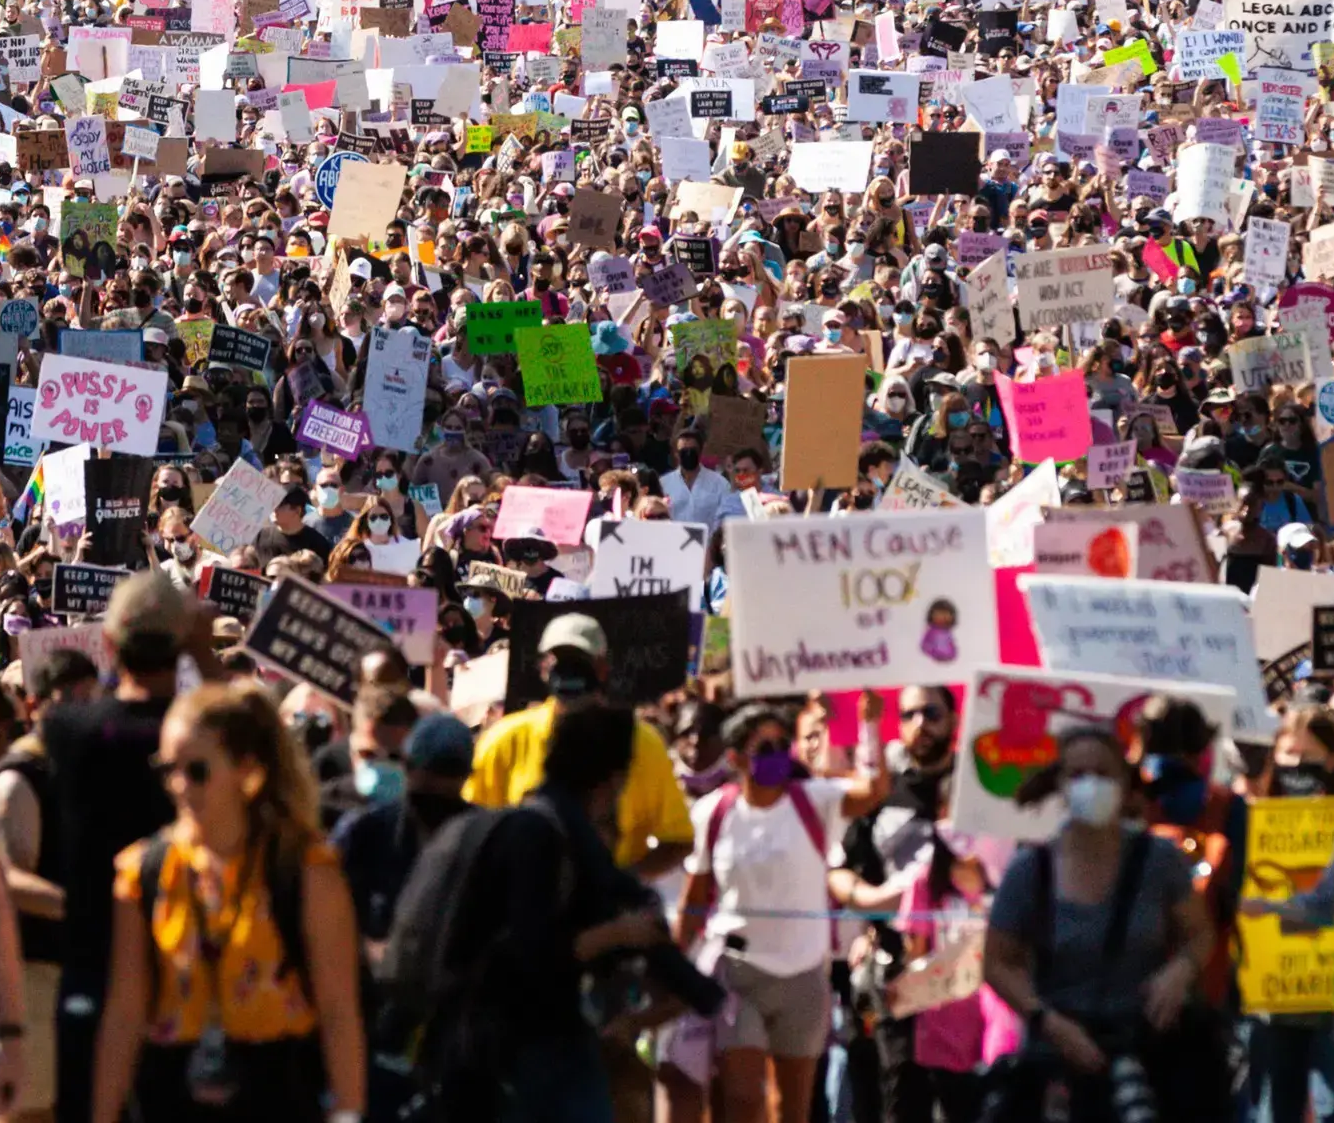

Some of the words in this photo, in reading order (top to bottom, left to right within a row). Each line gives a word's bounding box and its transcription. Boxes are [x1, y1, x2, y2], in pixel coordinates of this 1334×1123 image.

[1242, 2, 1296, 16] LEGAL
[1229, 20, 1276, 34] ONCE
[1282, 22, 1317, 34] AND
[159, 35, 167, 44] A
[14, 59, 37, 67] YOUR
[121, 94, 136, 104] FUN
[75, 119, 93, 130] MY
[1262, 124, 1297, 140] TEXAS
[74, 131, 101, 147] BODY
[80, 150, 95, 160] MY
[74, 159, 110, 175] CHOICE
[1018, 264, 1031, 278] WE
[1033, 260, 1053, 277] ARE
[1064, 281, 1084, 297] ACT
[1029, 302, 1105, 325] ACCORDINGLY
[217, 329, 236, 341] YOUR
[238, 334, 266, 349] REASON
[237, 343, 251, 353] THE
[211, 349, 231, 359] RIGHT
[234, 353, 263, 366] REASON
[61, 371, 137, 404] PUSSY
[84, 399, 99, 415] IS
[49, 408, 129, 445] POWER
[311, 405, 352, 429] ABORTION
[353, 418, 362, 432] IS
[305, 420, 357, 450] FREEDOM
[895, 473, 934, 501] LEAVE
[95, 505, 141, 524] OBJECT
[772, 528, 853, 564] MEN
[865, 521, 965, 556] Cause
[64, 570, 91, 581] KEEP
[220, 573, 243, 587] KEEP
[65, 583, 93, 595] LAWS
[67, 598, 84, 608] MY
[350, 588, 407, 608] BANS
[289, 588, 329, 625] KEEP
[277, 612, 325, 650] LAWS
[269, 638, 298, 664] MY
[299, 654, 346, 693] BODY
[743, 640, 890, 684] Unplanned
